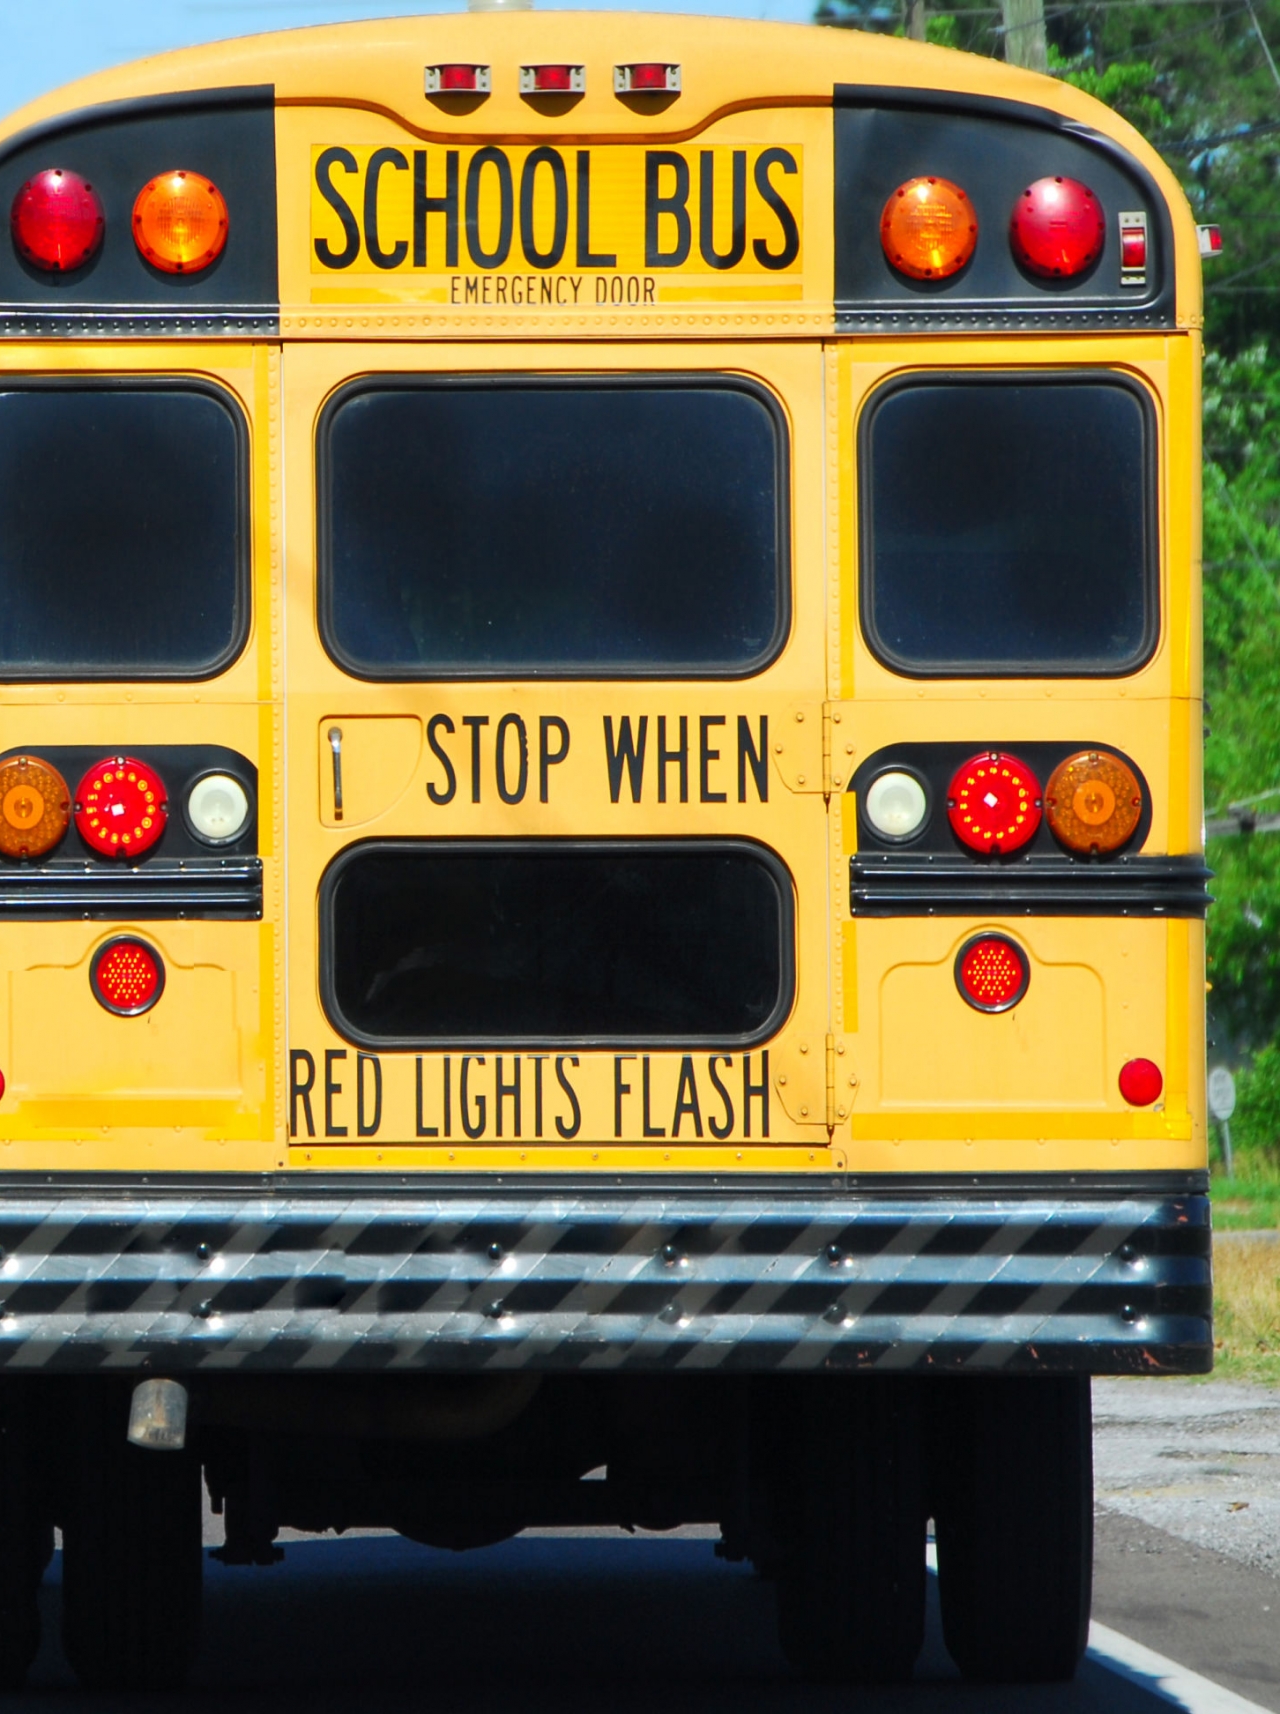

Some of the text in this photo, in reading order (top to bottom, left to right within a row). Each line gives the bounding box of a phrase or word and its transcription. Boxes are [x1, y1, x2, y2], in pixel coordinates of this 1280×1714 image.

[314, 145, 800, 271] SCHOOL BUS
[450, 275, 657, 307] EMERGENCY DOOR
[425, 713, 769, 806] STOP WHEN
[289, 1048, 770, 1140] RED LIGHTS FLASH
